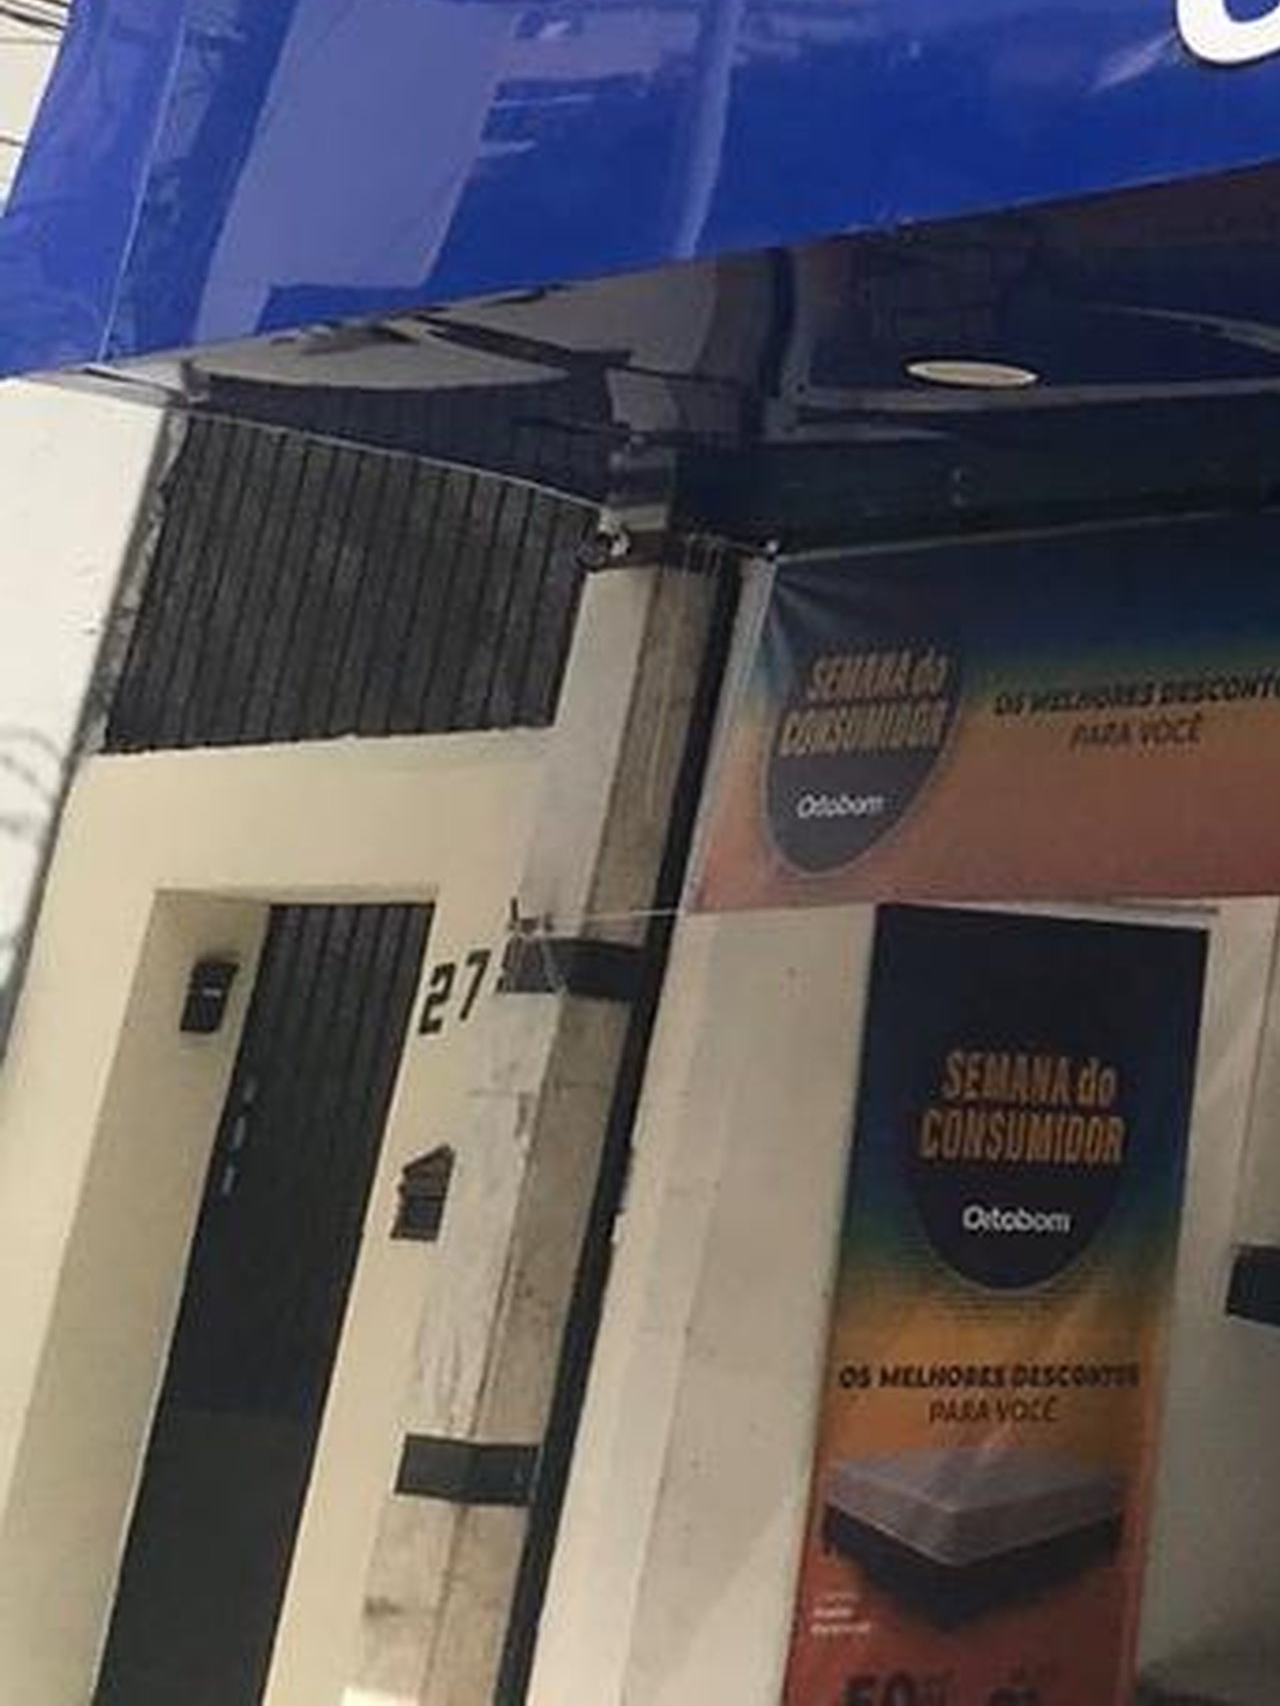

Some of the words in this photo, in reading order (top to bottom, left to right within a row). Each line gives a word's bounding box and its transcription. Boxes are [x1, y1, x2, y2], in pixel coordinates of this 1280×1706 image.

[418, 949, 491, 1035] 27
[943, 1051, 1071, 1104] SEMANA
[1077, 1057, 1118, 1107] do
[918, 1109, 1125, 1164] CONSUMIDOR
[838, 1366, 872, 1389] OS
[928, 1399, 988, 1424] PARA
